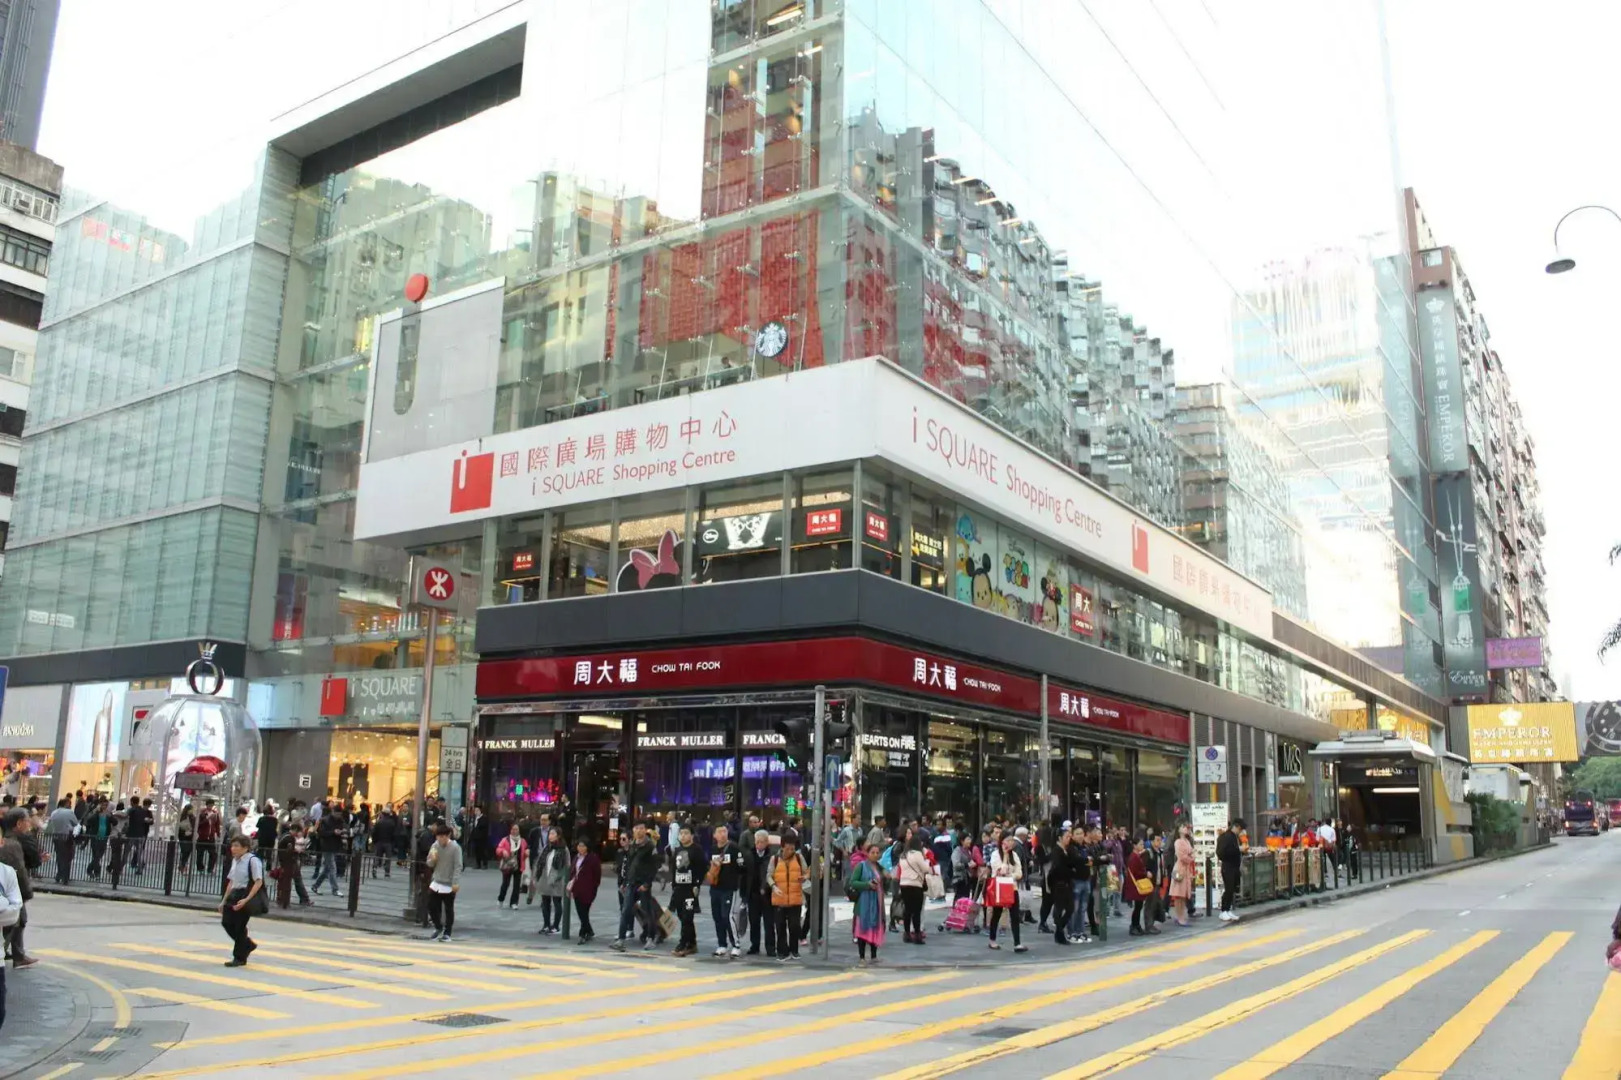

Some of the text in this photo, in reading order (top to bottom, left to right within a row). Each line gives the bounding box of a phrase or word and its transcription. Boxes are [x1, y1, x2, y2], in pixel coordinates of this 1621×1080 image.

[1437, 394, 1454, 463] EMPEROR
[500, 410, 737, 478] 國際廣場購物中心
[531, 449, 736, 496] i SQUARE Shopping Centre
[913, 406, 1102, 538] i SQUARE Shopping Centre
[573, 658, 638, 686] 周大福
[651, 661, 721, 673] CHOW TAI FOOK
[913, 657, 957, 691] 周大福
[351, 677, 417, 700] i SQUARE
[963, 677, 978, 688] CHOW
[979, 681, 987, 689] TAI
[1060, 692, 1090, 718] 周大福
[637, 735, 724, 747] FRANCK MULLER
[743, 733, 786, 745] FRANCK
[861, 733, 916, 750] HEARTS ON FIRE
[1473, 726, 1551, 739] EMPEROR
[444, 749, 463, 757] 24 hrs
[485, 739, 555, 749] FRANCK MULLER
